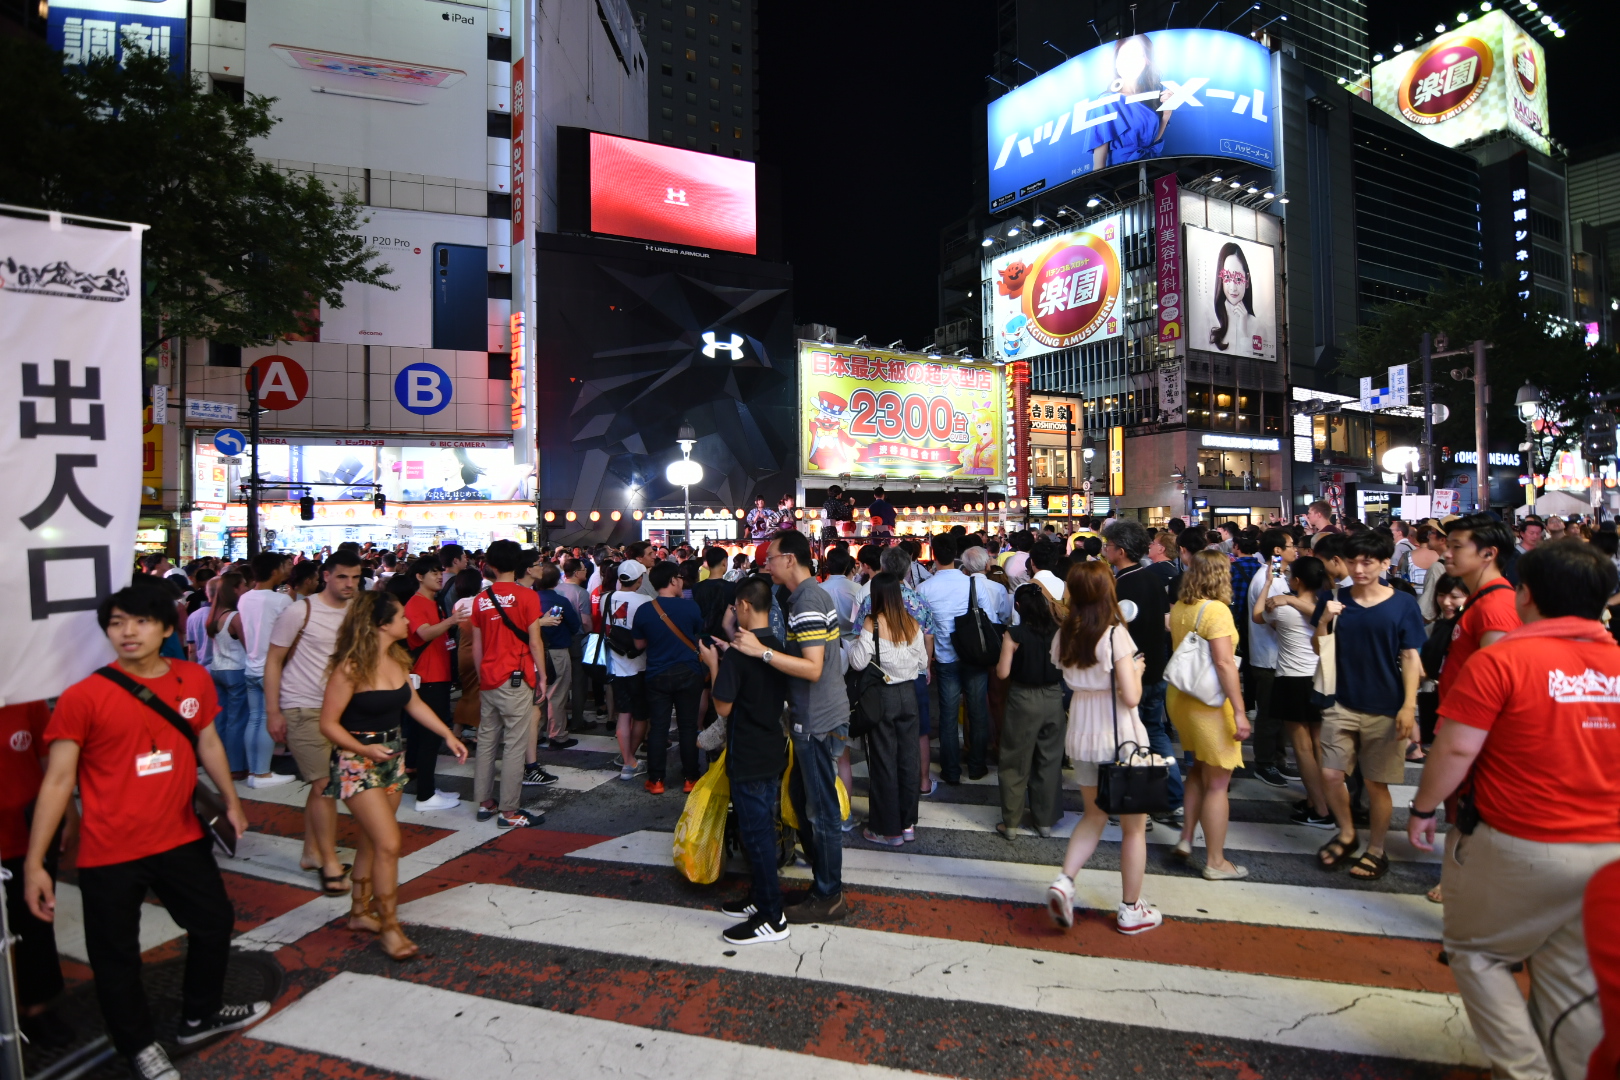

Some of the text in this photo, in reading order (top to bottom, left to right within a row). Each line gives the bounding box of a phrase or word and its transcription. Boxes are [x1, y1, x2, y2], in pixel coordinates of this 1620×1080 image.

[451, 13, 475, 25] iPad
[514, 79, 524, 116] 免税
[1413, 55, 1479, 107] 楽園
[1402, 75, 1490, 125] EXCITING AMUSEMENT
[993, 78, 1268, 171] ハッピーメール
[1235, 144, 1270, 160] ハッピーメール
[372, 236, 391, 246] P20
[394, 238, 411, 247] Pro
[654, 246, 710, 258] UNDER ARMOUR
[1159, 196, 1177, 292] 品川美容外科
[1036, 264, 1104, 318] 楽園
[1026, 295, 1116, 347] EXCITING AMUSEMENT
[258, 361, 298, 399] A
[406, 371, 443, 408] B
[811, 351, 992, 391] 日本最大級の超大型店
[191, 402, 234, 414] 道玄坂下
[1032, 403, 1067, 421] 吉野家
[1488, 453, 1521, 466] NEMAS
[19, 359, 115, 621] 出入口
[1084, 482, 1090, 490] 3
